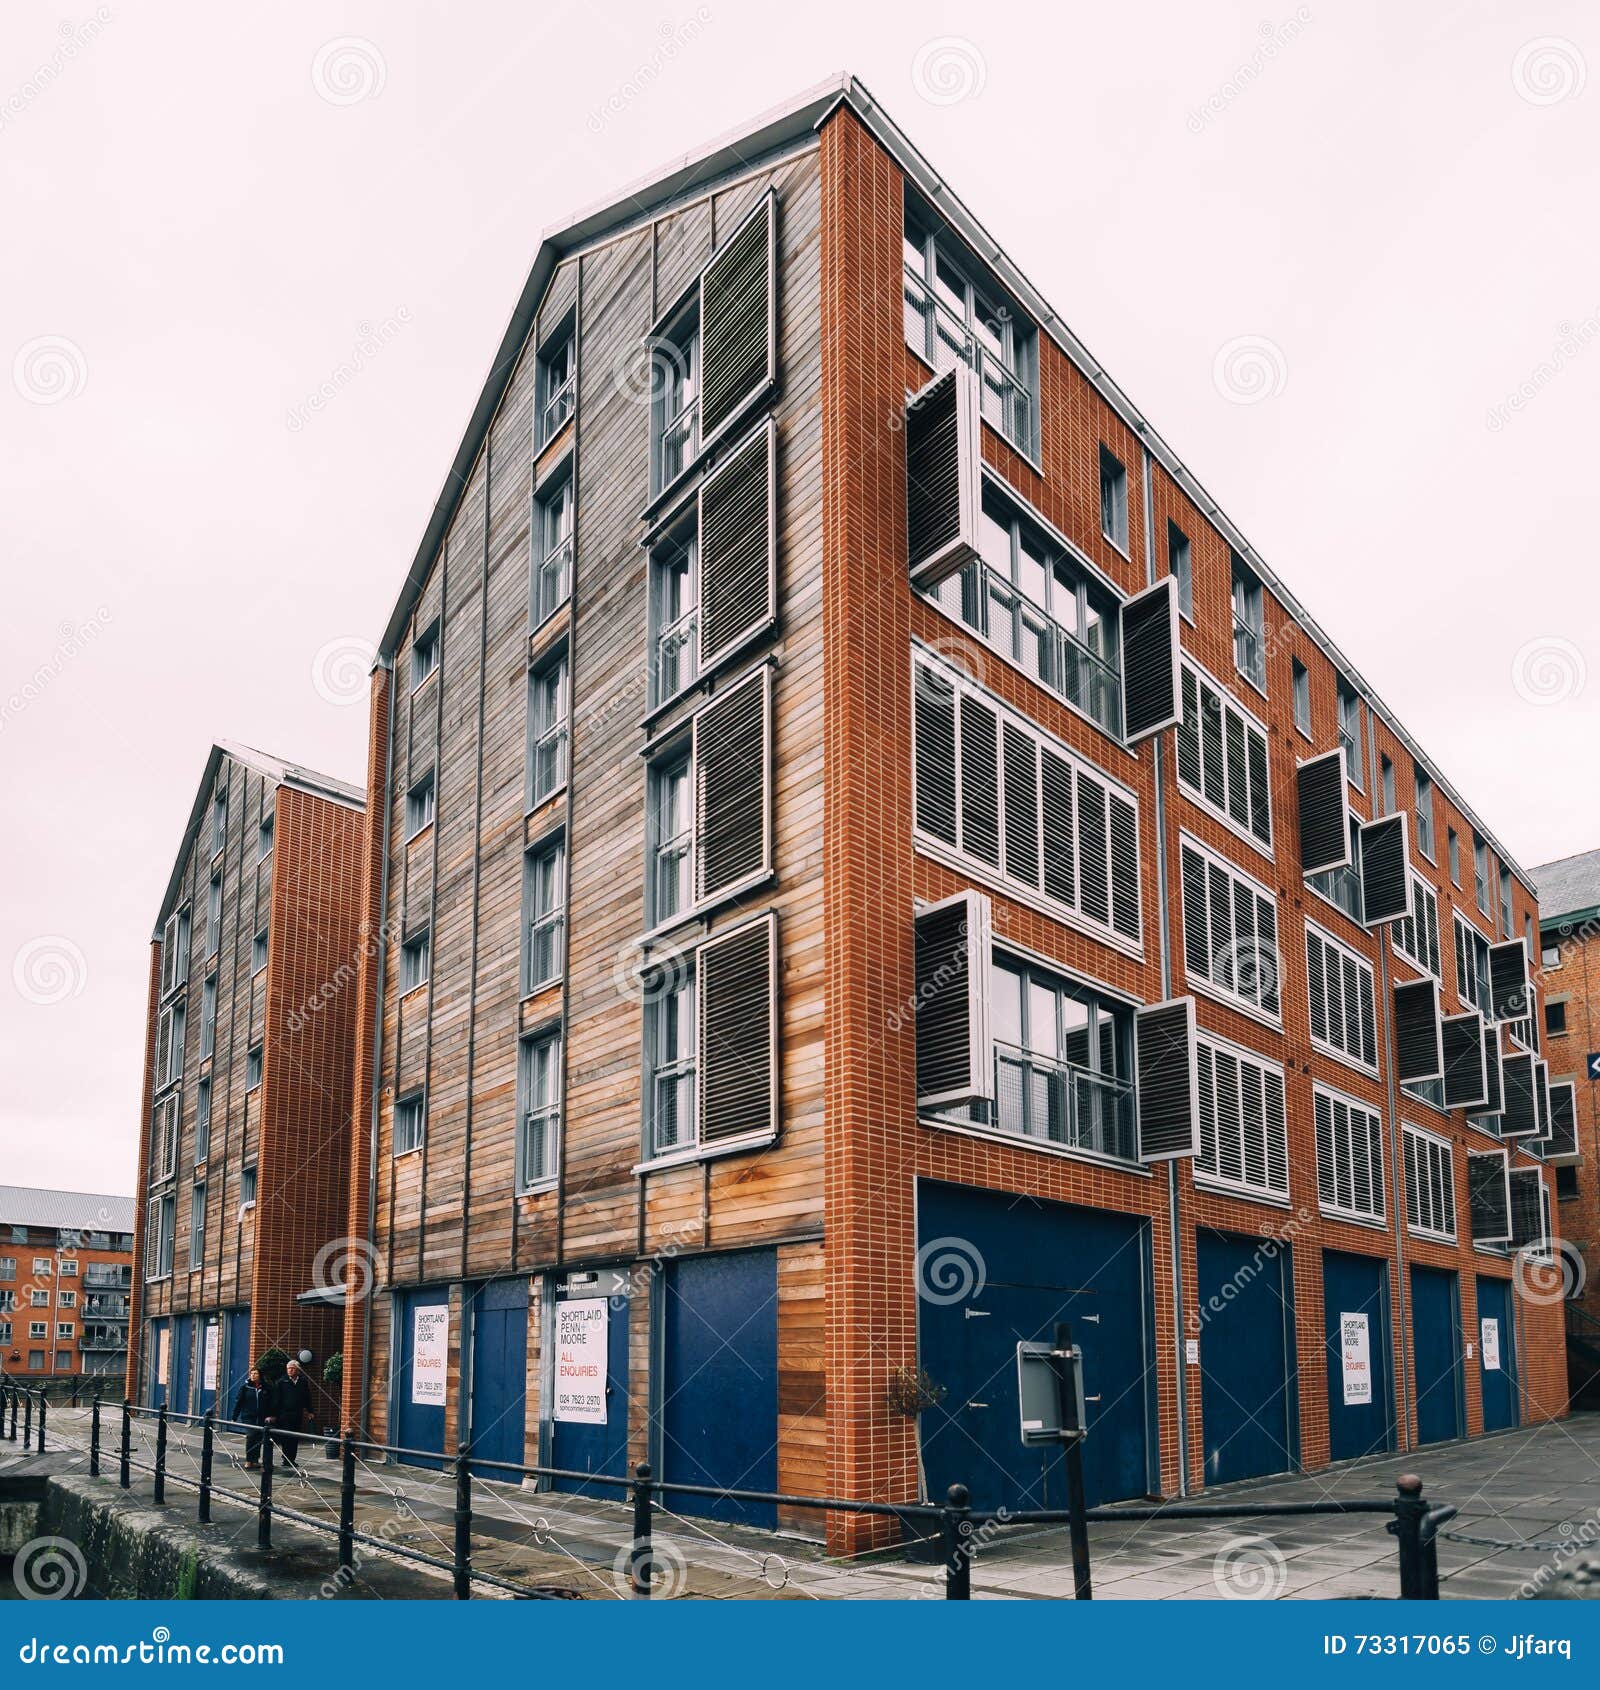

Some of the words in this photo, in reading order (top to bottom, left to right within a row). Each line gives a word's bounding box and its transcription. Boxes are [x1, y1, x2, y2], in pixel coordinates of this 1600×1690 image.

[418, 1314, 446, 1324] SHORTLAND
[560, 1310, 602, 1322] SHORTLAND
[417, 1333, 435, 1342] MOORE
[560, 1333, 587, 1344] MOORE
[561, 1351, 575, 1362] ALL
[560, 1365, 598, 1377] ENQUIRIES
[559, 1394, 570, 1404] 024
